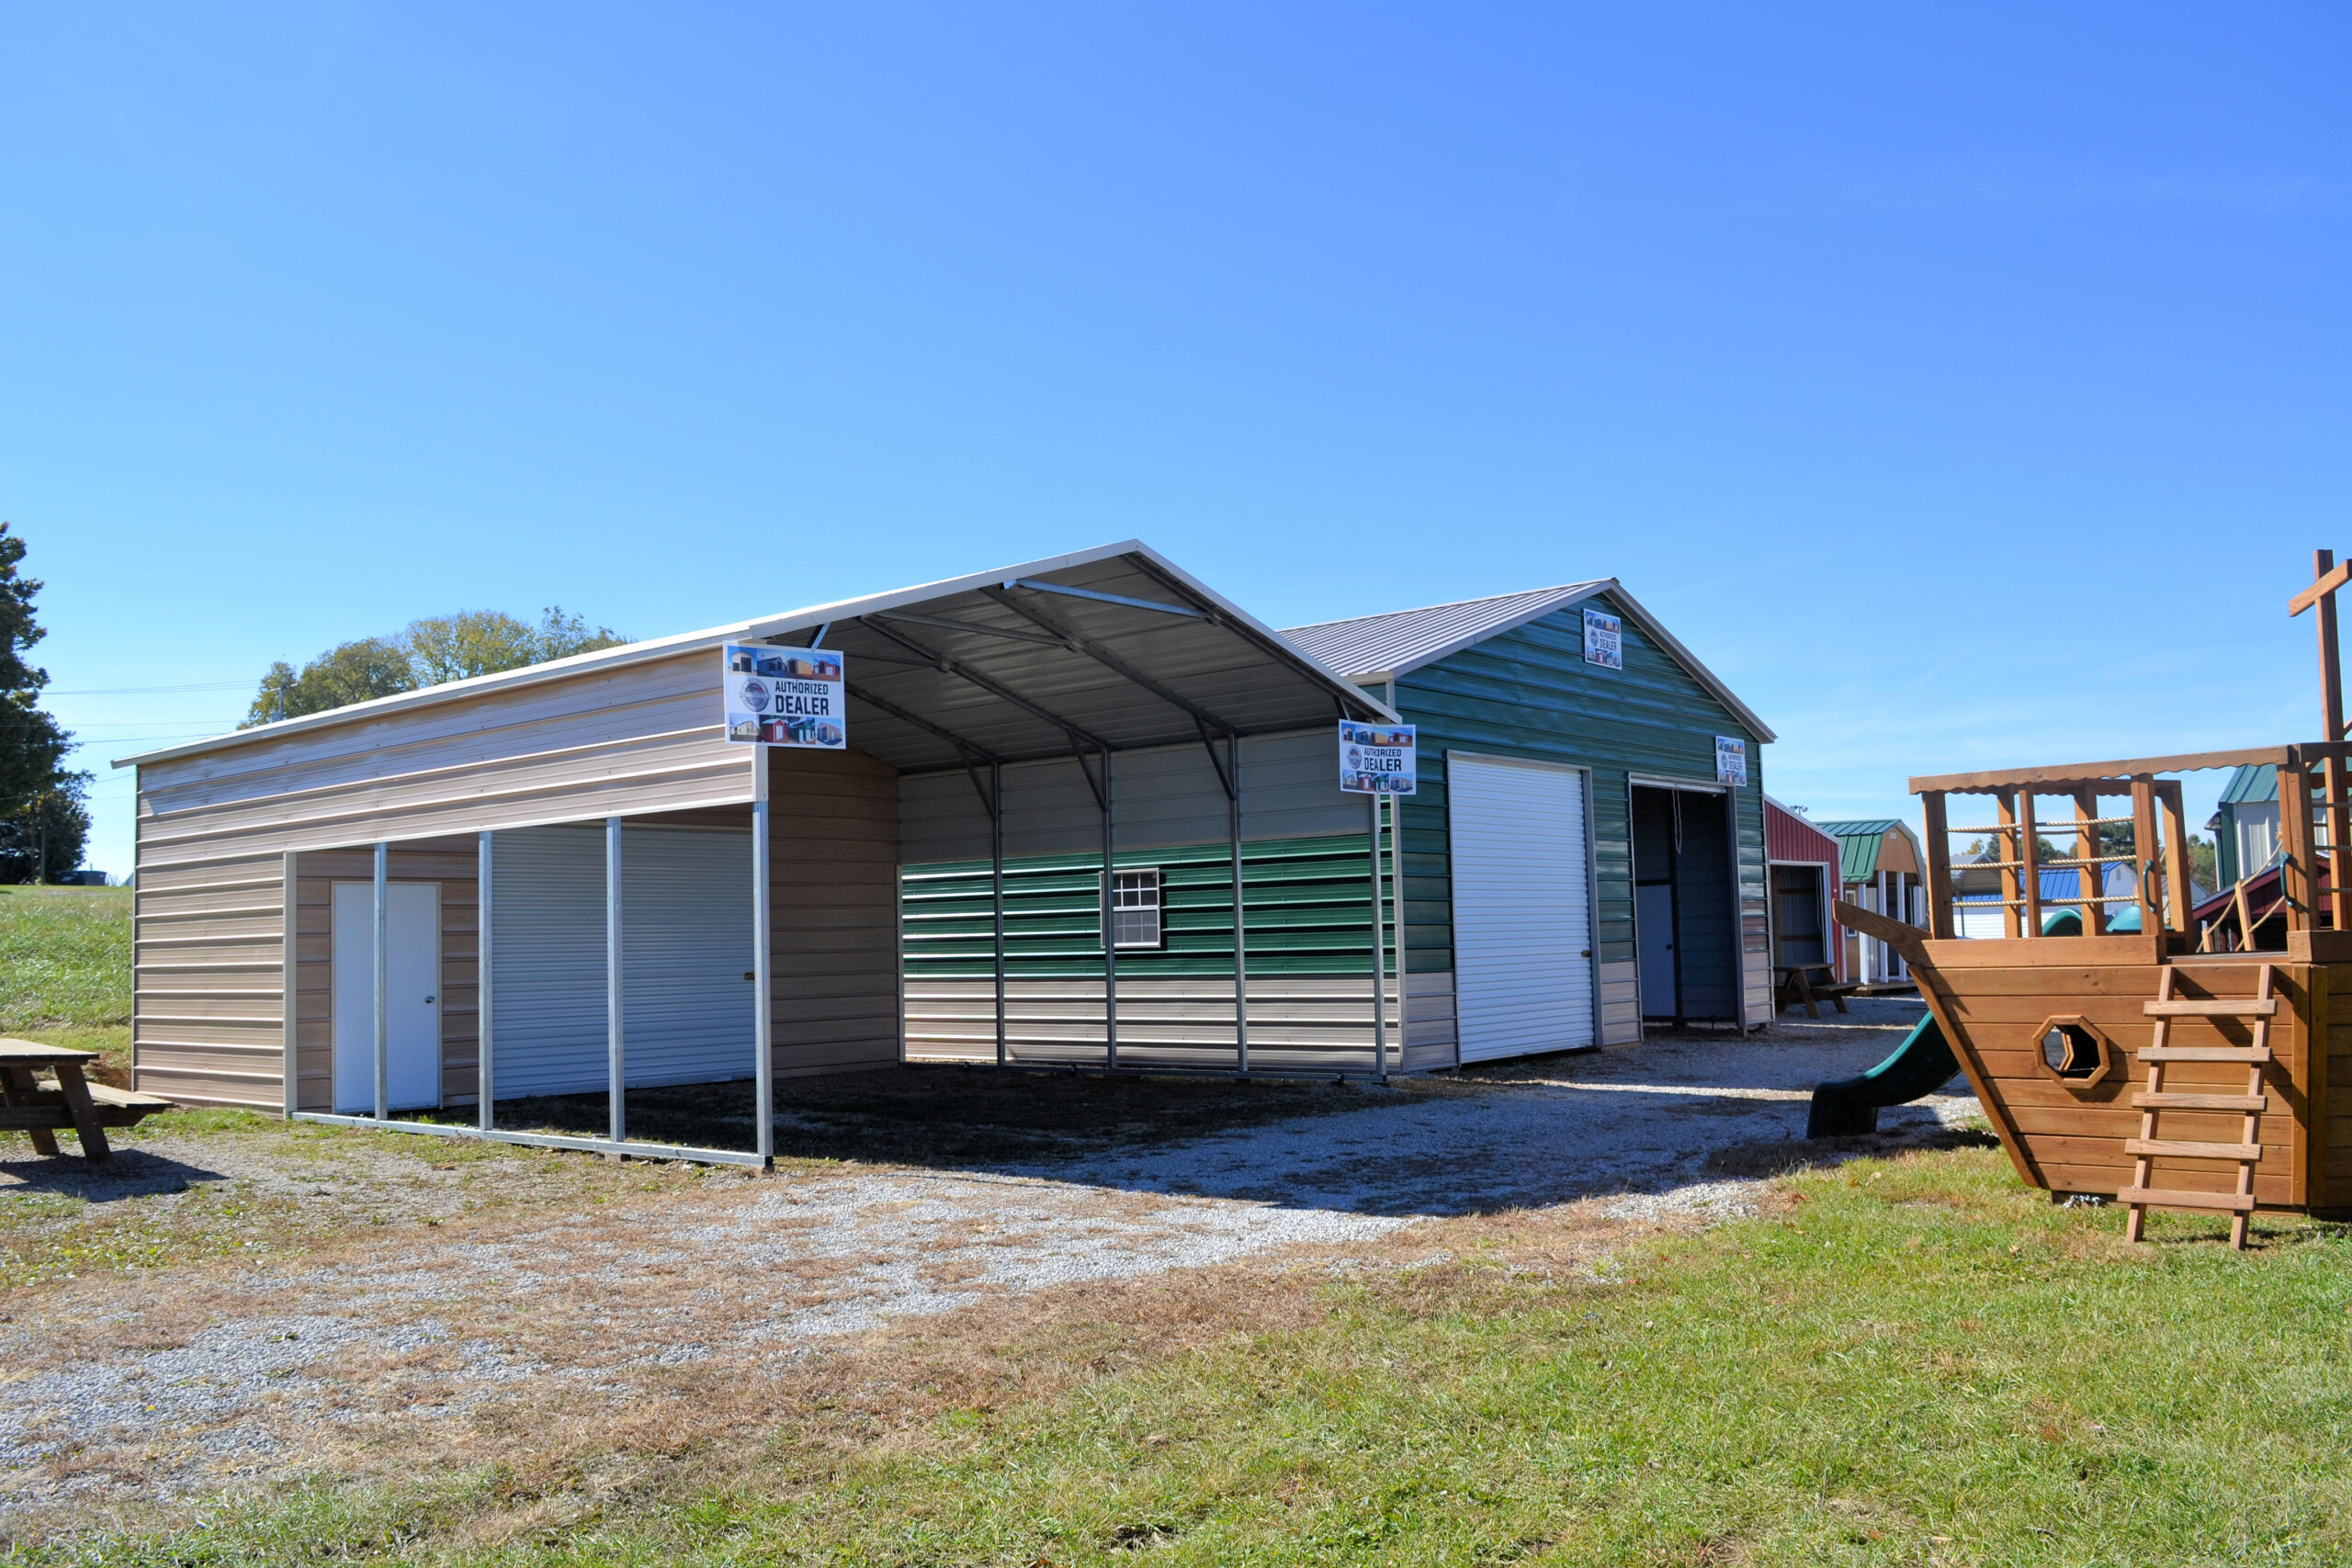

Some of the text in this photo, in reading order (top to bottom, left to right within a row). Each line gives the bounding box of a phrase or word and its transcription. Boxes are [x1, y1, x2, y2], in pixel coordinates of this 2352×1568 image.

[1600, 638, 1617, 651] DEALER
[775, 681, 829, 695] AUTHORIZED
[775, 694, 830, 716] DEALER
[1364, 747, 1402, 757] AUTHORIZED
[1364, 758, 1402, 772] DEALER
